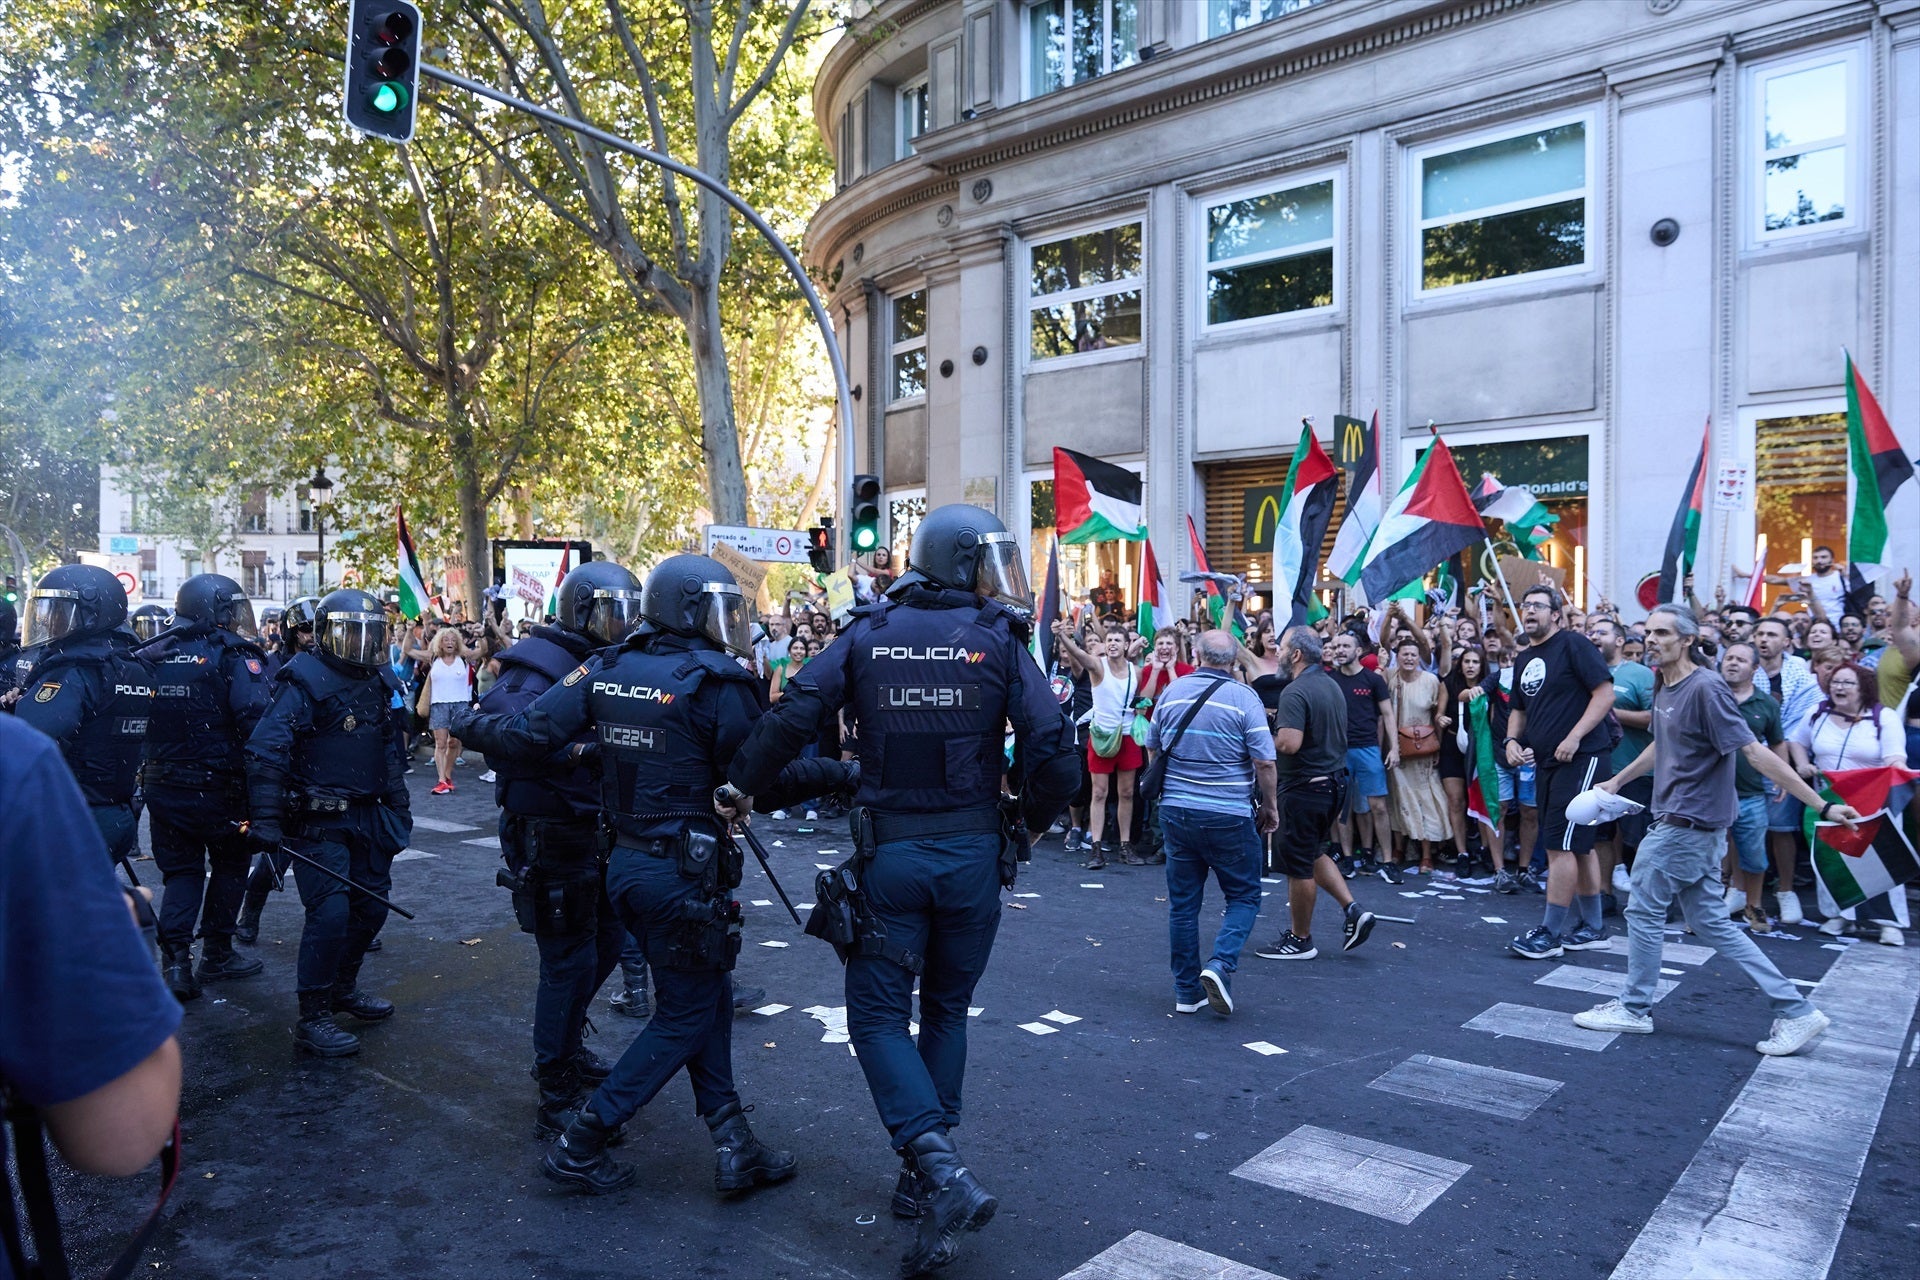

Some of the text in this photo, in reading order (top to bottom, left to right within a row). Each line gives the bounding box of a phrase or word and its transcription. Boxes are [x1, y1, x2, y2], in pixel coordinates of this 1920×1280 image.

[1518, 480, 1588, 494] Donald's
[711, 533, 747, 541] mercado de
[512, 568, 528, 586] FREE
[529, 578, 545, 597] FREE
[158, 655, 199, 664] LICIA
[872, 646, 971, 661] POLICIA
[115, 684, 152, 696] POLICIA
[592, 681, 662, 701] POLICIA
[889, 688, 962, 707] UC431
[603, 725, 654, 749] UC224
